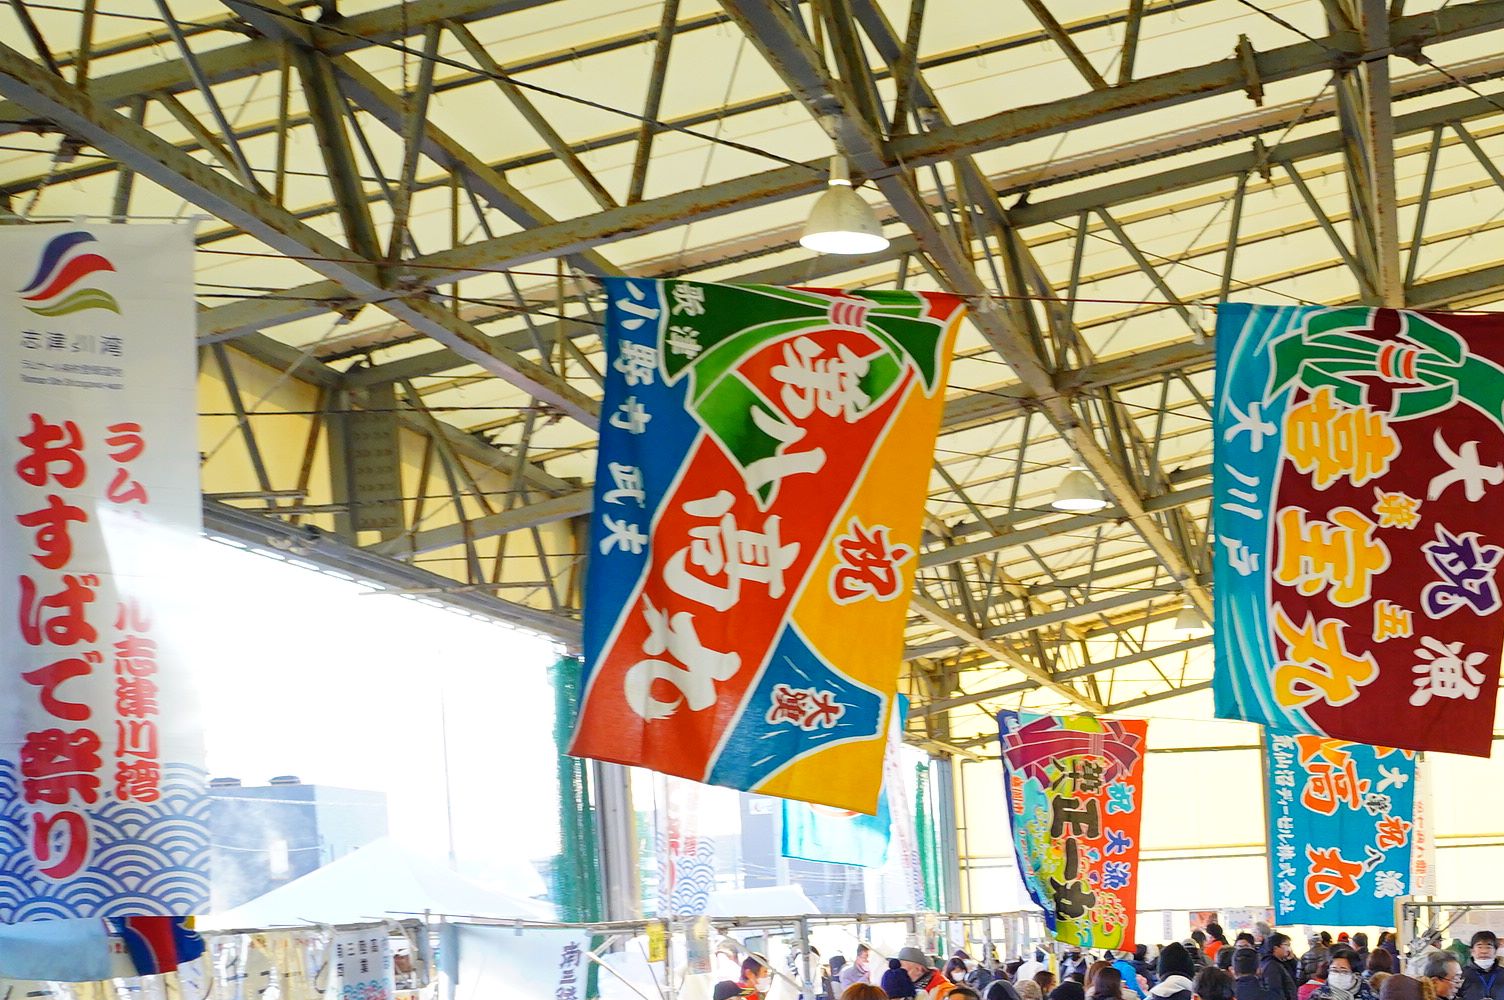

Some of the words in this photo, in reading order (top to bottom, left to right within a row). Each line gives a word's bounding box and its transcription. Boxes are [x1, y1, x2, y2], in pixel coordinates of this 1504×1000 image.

[14, 411, 103, 880] おすばで祭り
[104, 421, 161, 802] ラムル志津川湾
[829, 515, 915, 607] 祝
[1274, 385, 1401, 712] 喜宝丸
